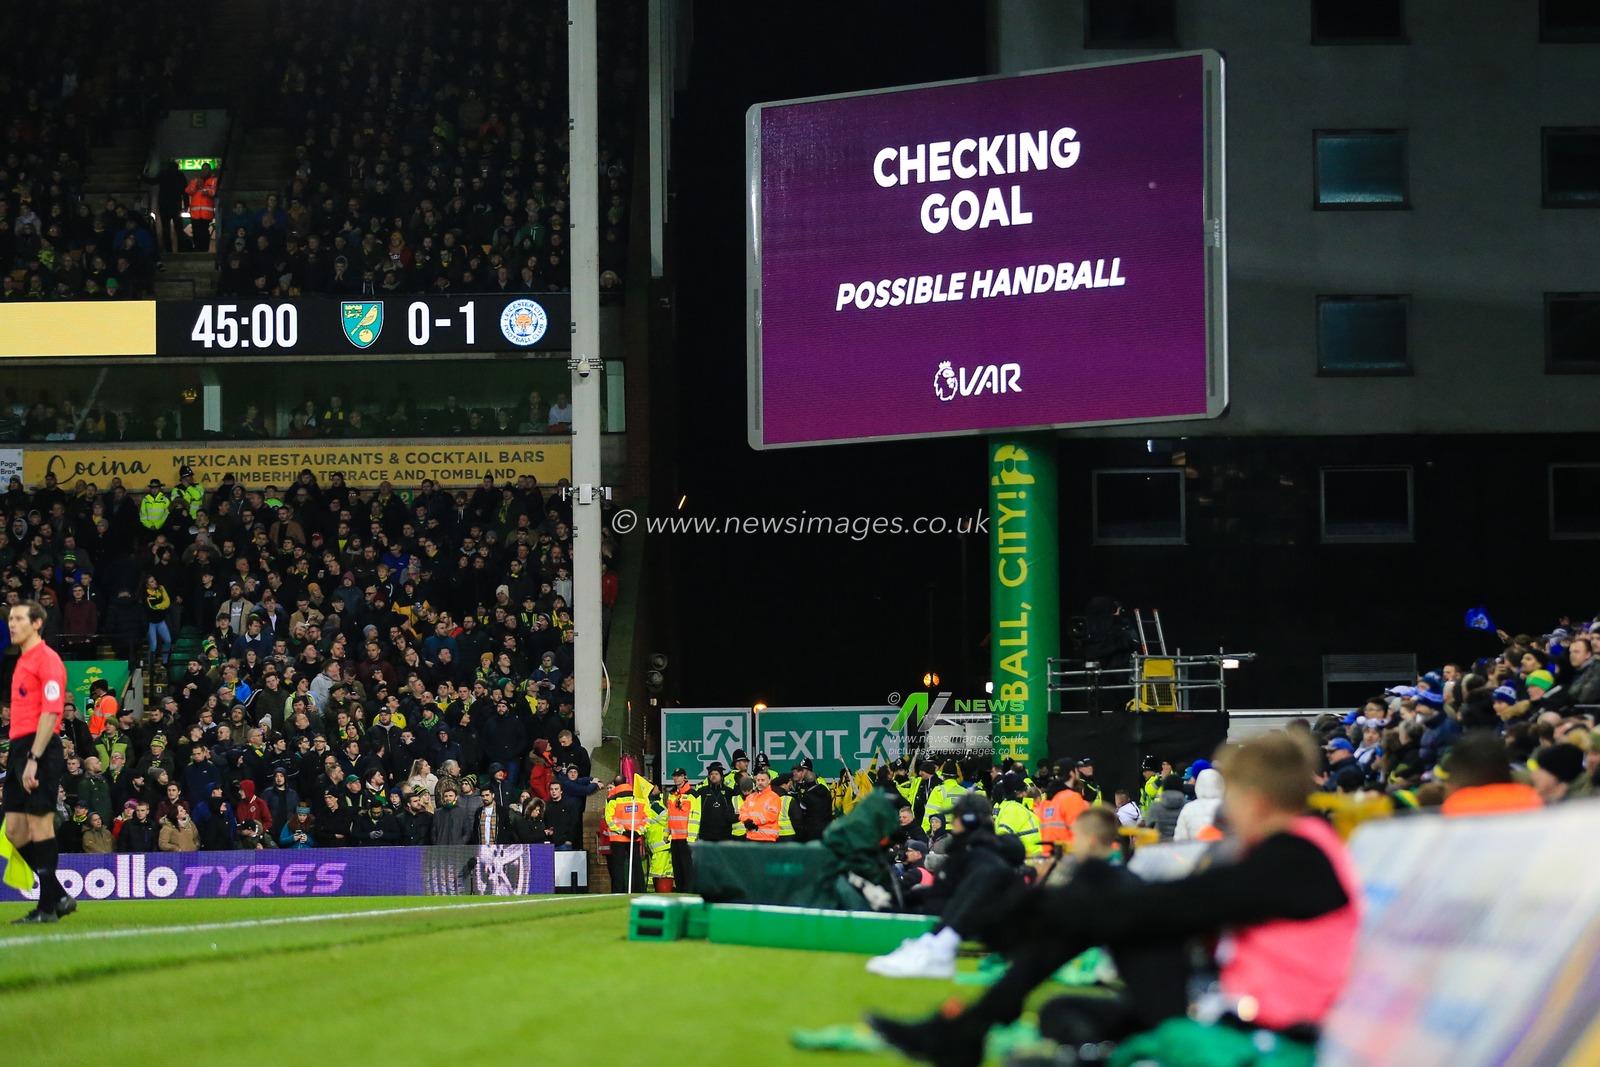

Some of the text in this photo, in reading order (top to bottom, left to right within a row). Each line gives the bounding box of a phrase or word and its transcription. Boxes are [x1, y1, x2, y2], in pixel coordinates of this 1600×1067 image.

[873, 127, 1081, 188] CHECKING
[920, 186, 1033, 234] GOAL
[836, 257, 1126, 311] POSSIBLE HANDBALL
[191, 303, 298, 348] 45:00
[959, 362, 1023, 397] VAR
[0, 460, 18, 469] Page
[46, 454, 151, 485] Cocina
[172, 450, 545, 467] MEXICAN RESTAURANTS & COCKTAIL BARS
[201, 472, 221, 483] AT
[225, 471, 311, 482] IMBERHI
[393, 469, 427, 481] AND
[430, 468, 516, 480] TOMBLAND
[996, 491, 1032, 776] HE BALL, CITY!
[667, 740, 703, 753] EXIT
[764, 729, 849, 760] EXIT
[183, 862, 347, 896] TYRES
